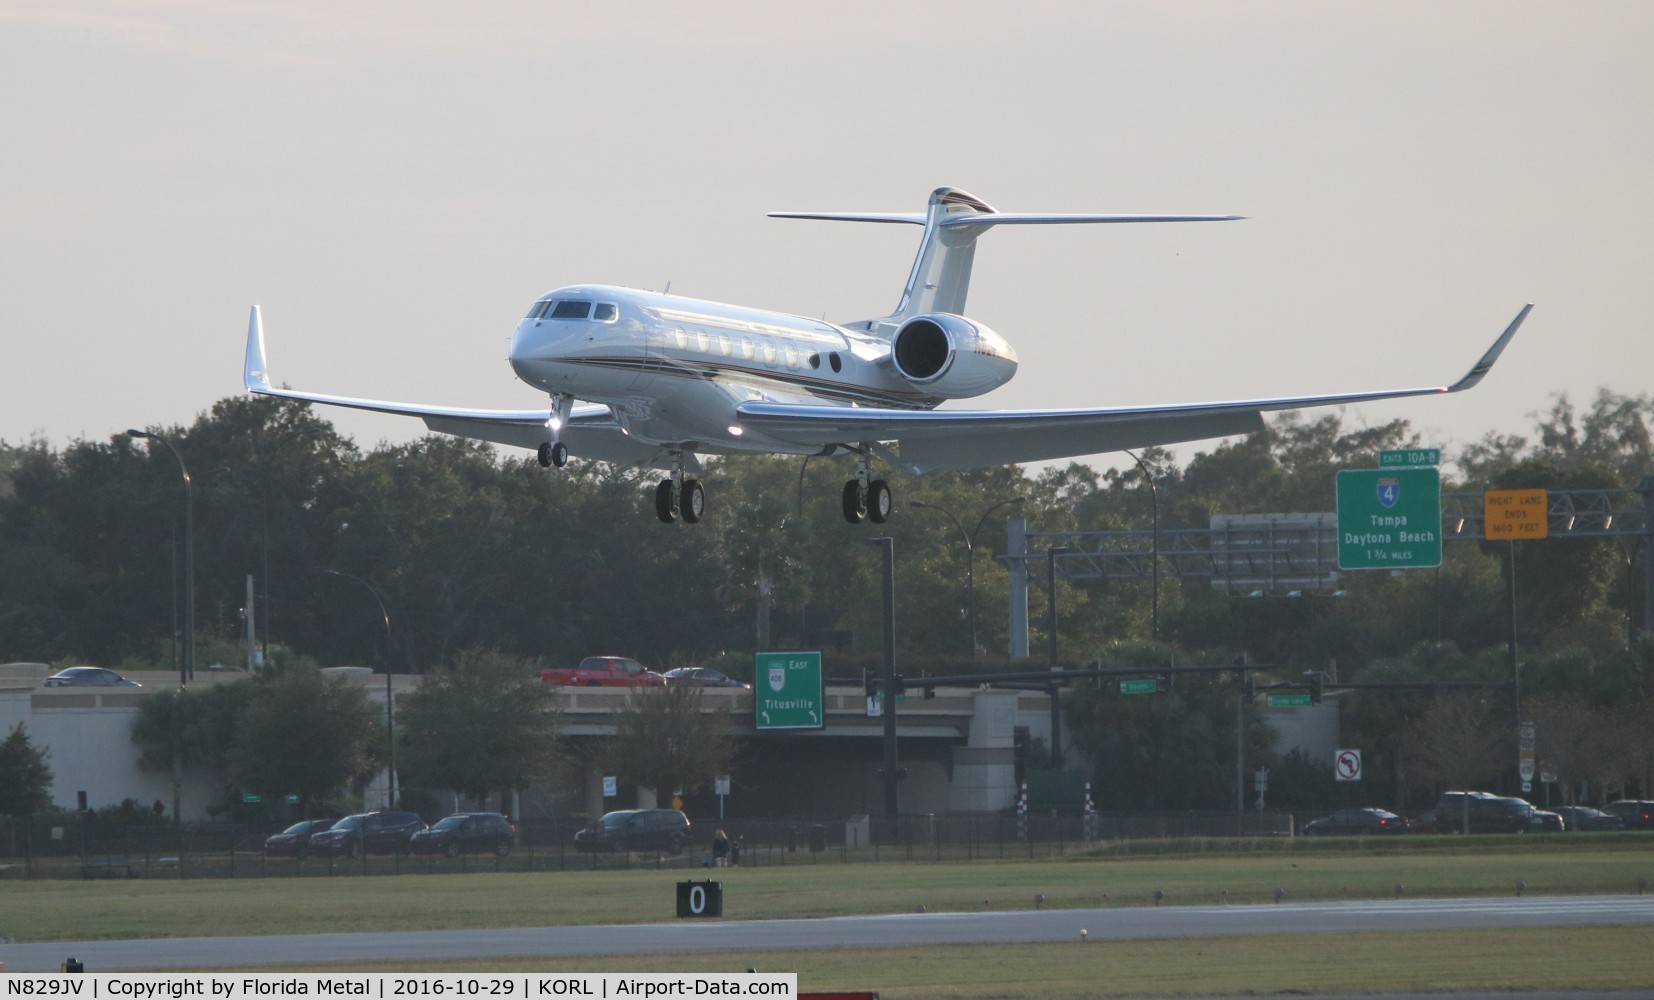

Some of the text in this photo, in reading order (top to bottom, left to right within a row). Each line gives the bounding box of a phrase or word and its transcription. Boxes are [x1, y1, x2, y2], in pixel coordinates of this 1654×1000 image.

[1407, 452, 1436, 463] 10A-B
[1384, 486, 1394, 501] 4
[1489, 496, 1543, 505] RIGHT LANE
[1504, 510, 1528, 519] ENDS
[1371, 515, 1408, 528] Tampa
[1519, 522, 1539, 532] FEET
[1345, 531, 1434, 546] Daytona Beach
[1392, 551, 1412, 560] MILES
[789, 661, 808, 669] EAST
[765, 700, 813, 710] Titusville
[690, 886, 706, 914] 0
